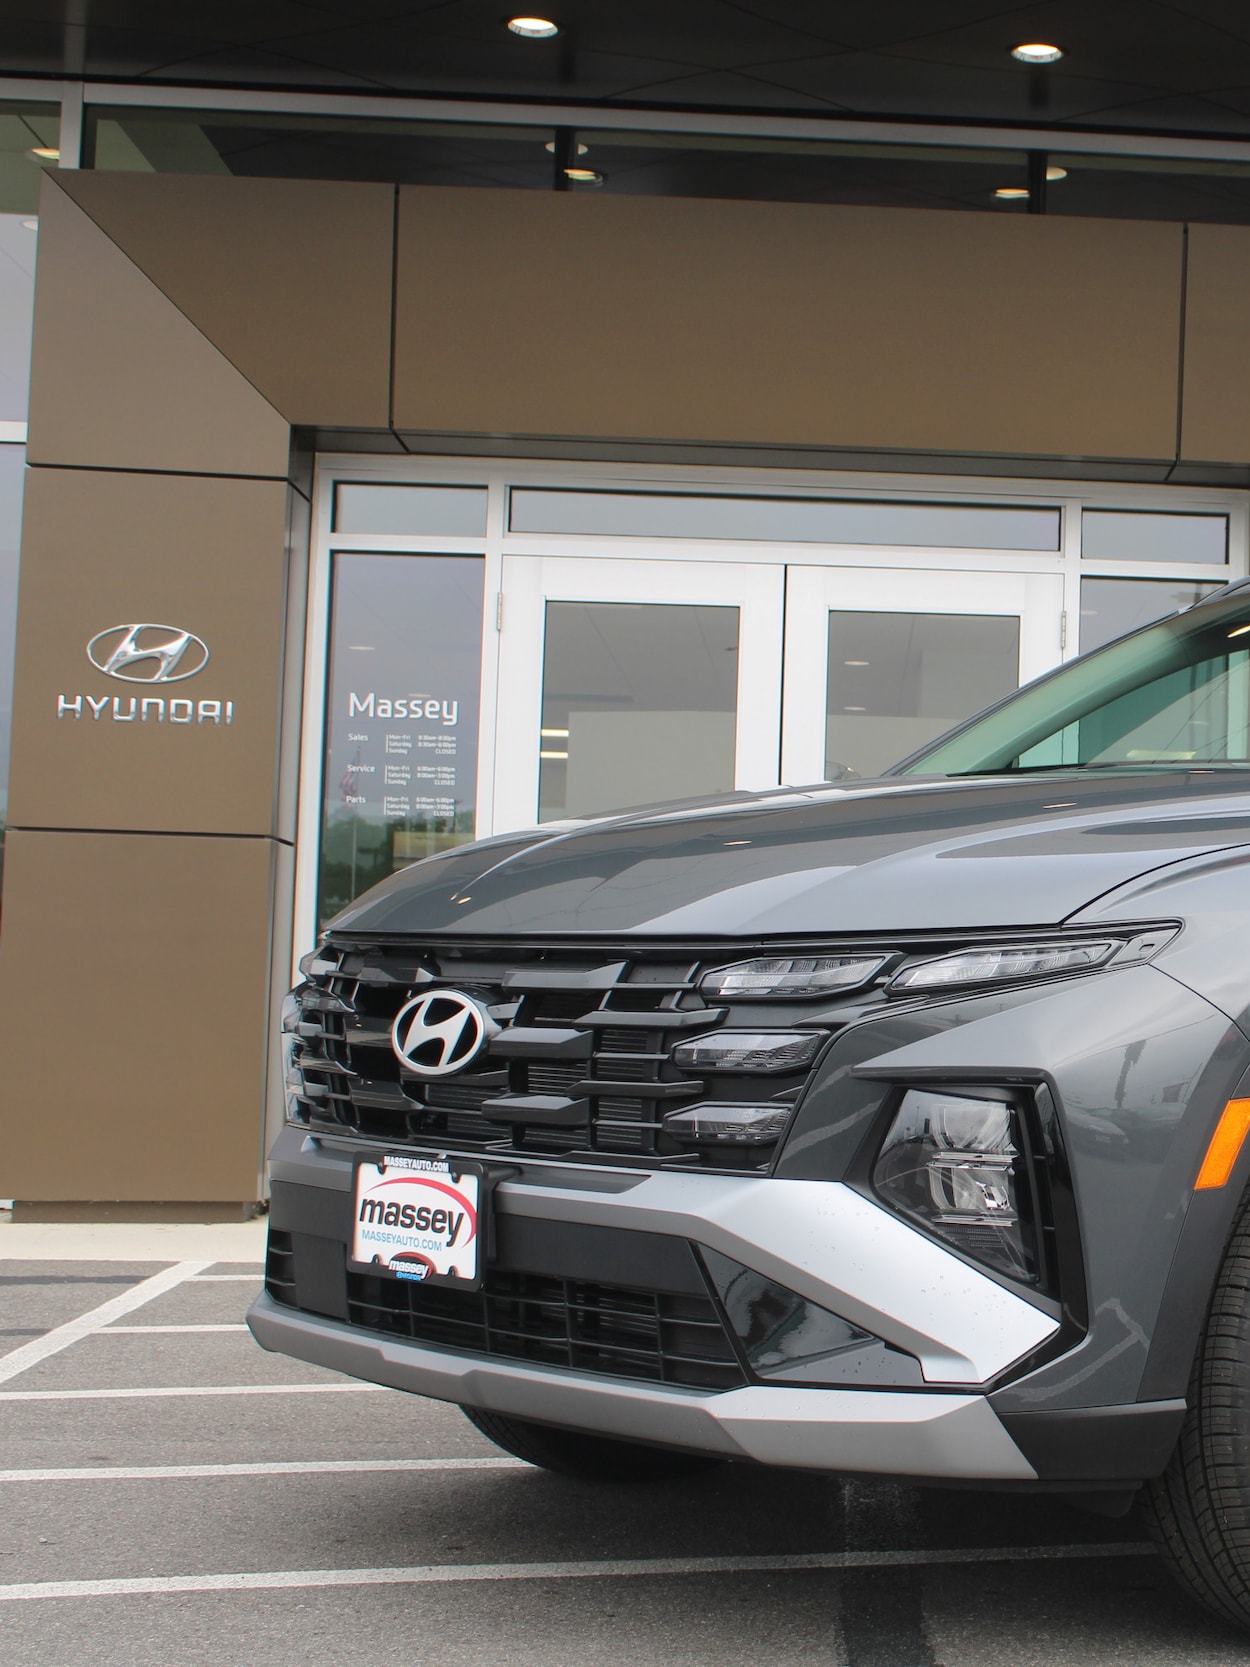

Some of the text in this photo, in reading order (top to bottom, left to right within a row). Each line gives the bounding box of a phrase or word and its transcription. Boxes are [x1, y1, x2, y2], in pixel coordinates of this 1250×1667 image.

[57, 694, 232, 725] HYUNDAI
[349, 692, 458, 726] Massey
[348, 733, 368, 741] Sales
[347, 765, 376, 773] Service
[346, 795, 366, 803] Parts
[383, 1155, 450, 1173] MASSEYAUTO.COM
[359, 1198, 465, 1248] massey
[361, 1229, 443, 1252] MASSEYAUTO.COM
[388, 1259, 429, 1279] massey
